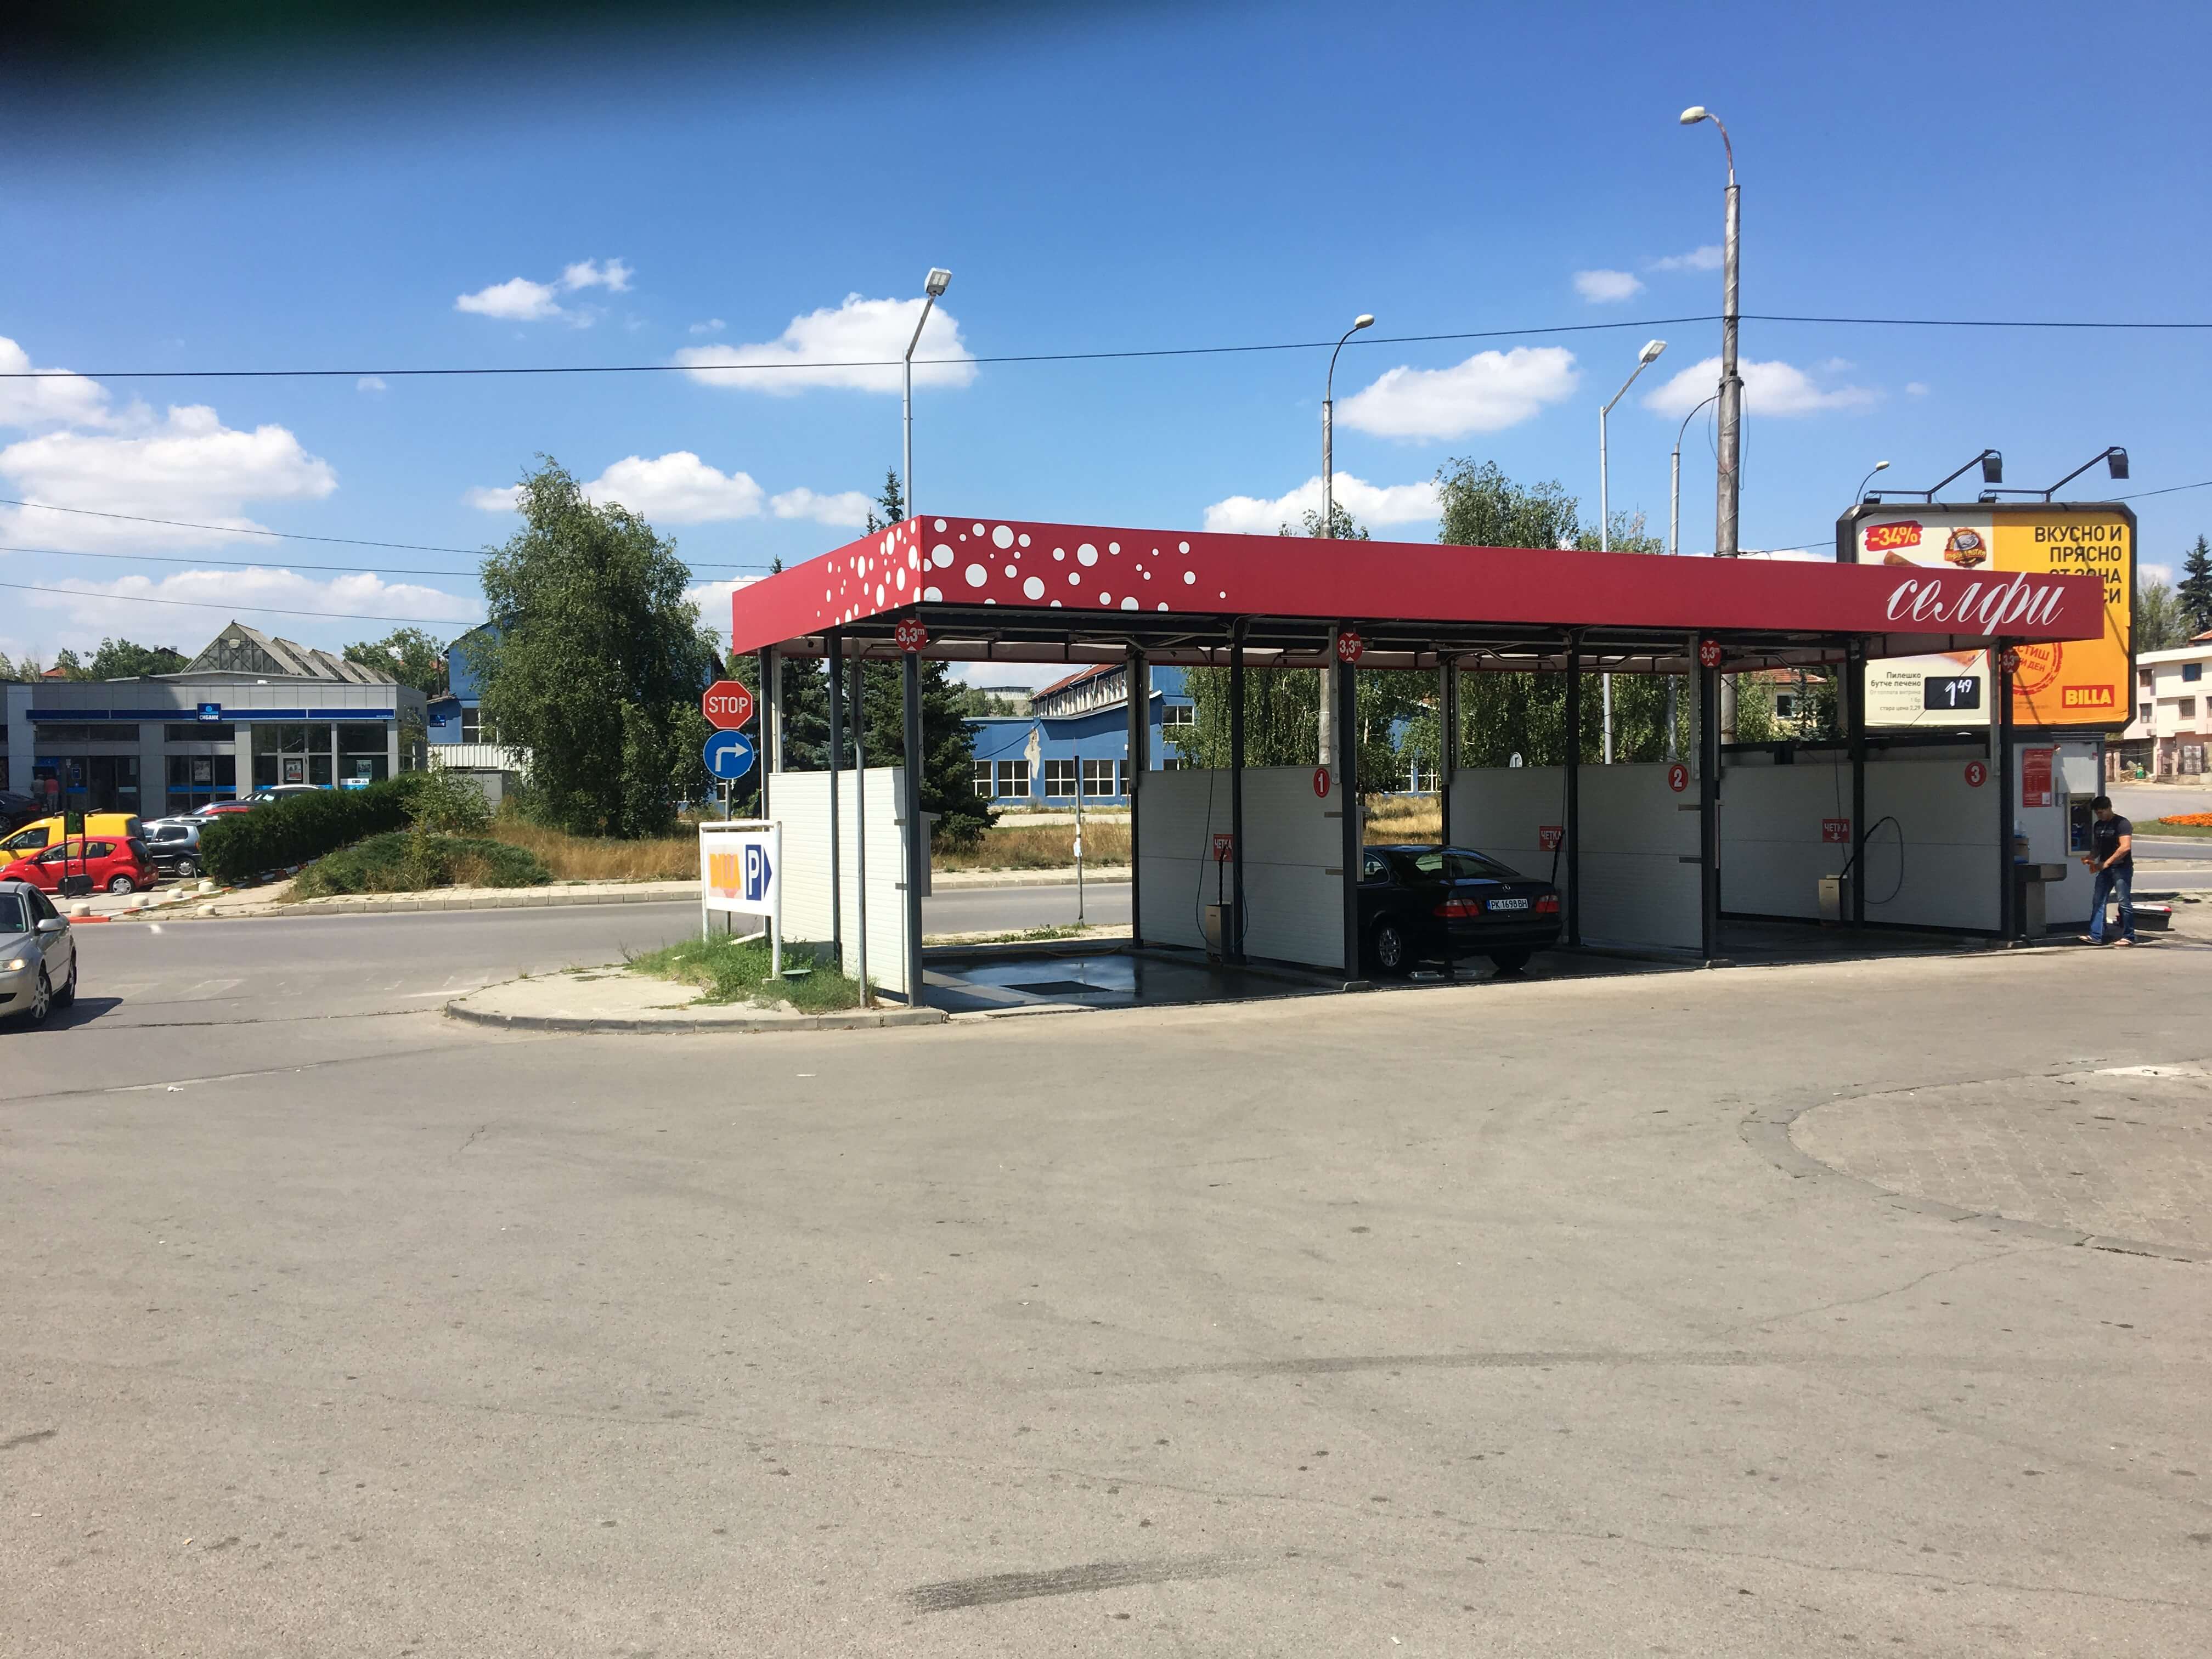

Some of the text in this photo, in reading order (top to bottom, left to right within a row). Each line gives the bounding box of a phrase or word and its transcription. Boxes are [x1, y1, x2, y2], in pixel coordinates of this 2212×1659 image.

[1871, 526, 1918, 546] -34%
[2034, 526, 2122, 543] ВКУСНО И
[2050, 545, 2122, 562] ПРЯСНО
[1887, 572, 2066, 635] селфи
[898, 627, 925, 645] 3,3m
[1339, 640, 1361, 656] 3,3m
[2027, 661, 2046, 672] ДЕН
[709, 696, 748, 713] STOP
[2066, 689, 2112, 705] BILLA
[1674, 769, 1682, 787] 2
[1971, 765, 1980, 782] 3
[1318, 773, 1323, 793] 1
[748, 850, 760, 895] P
